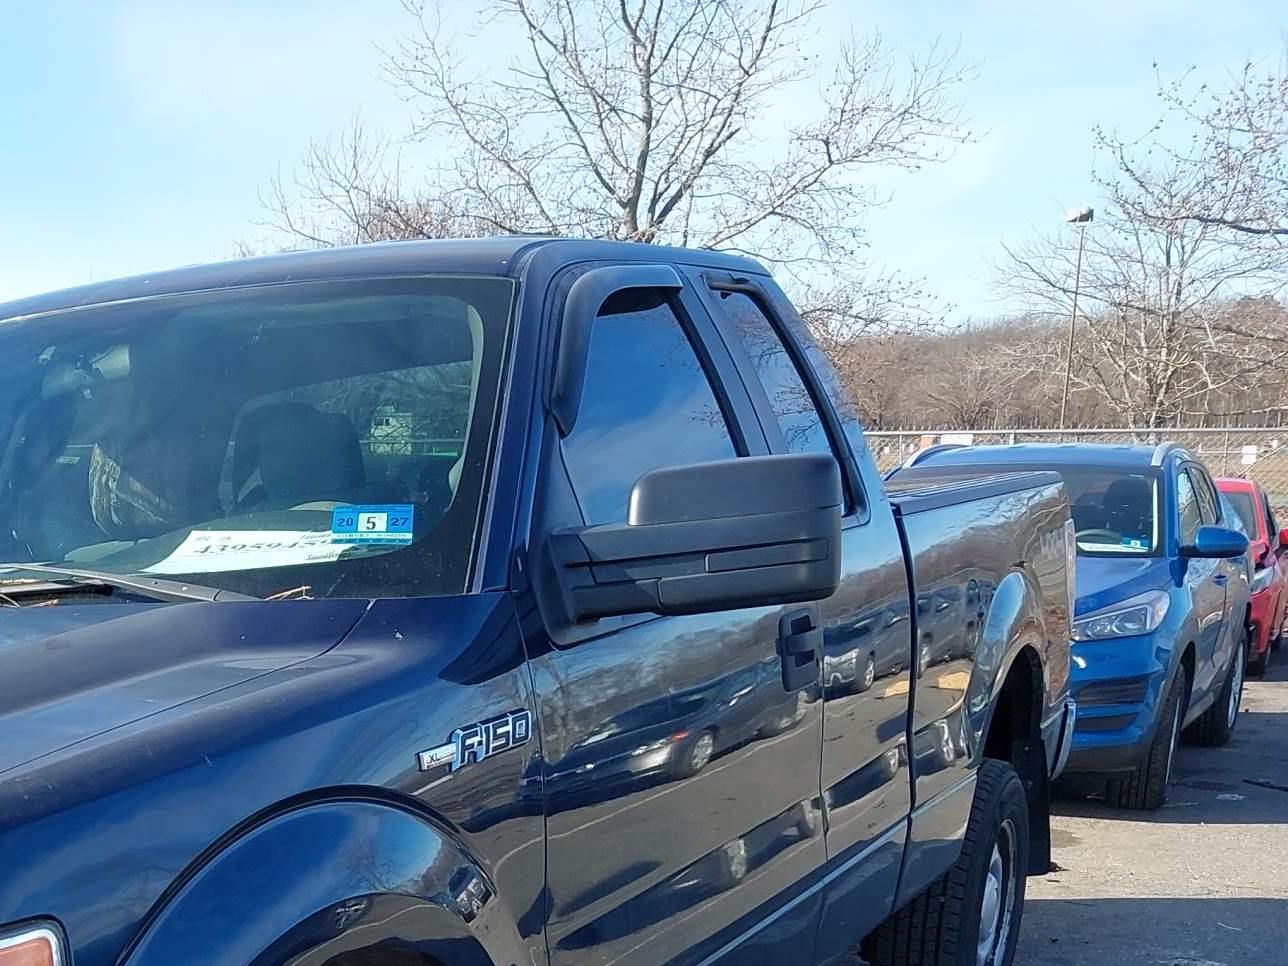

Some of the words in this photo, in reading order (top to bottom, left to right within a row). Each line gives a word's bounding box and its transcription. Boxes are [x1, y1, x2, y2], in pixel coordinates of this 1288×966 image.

[337, 517, 354, 527] 20
[366, 516, 377, 530] 5
[391, 517, 409, 527] 27
